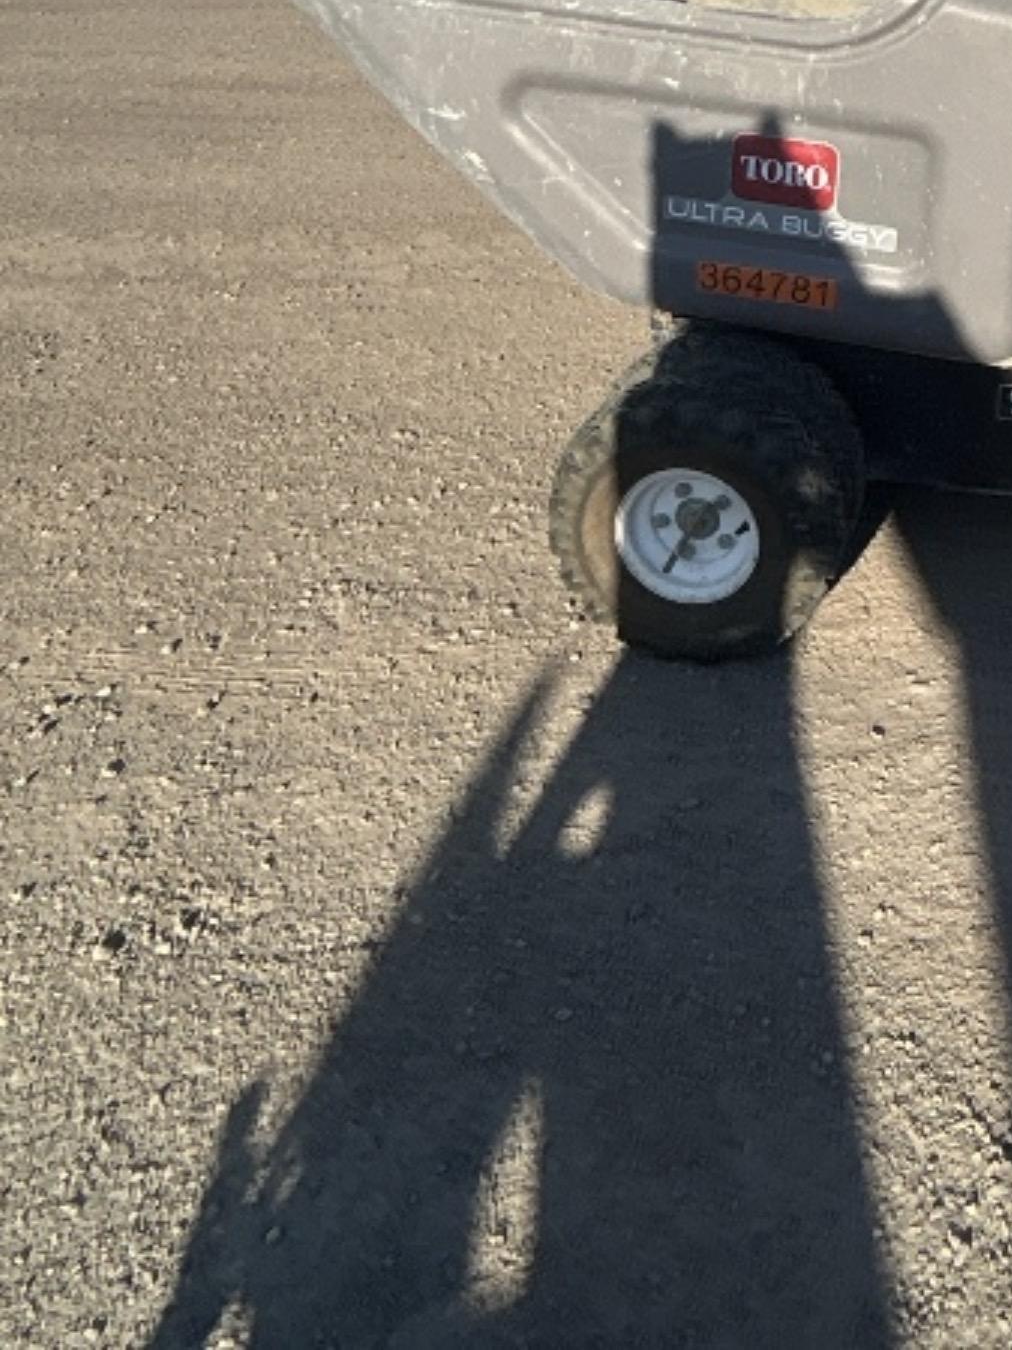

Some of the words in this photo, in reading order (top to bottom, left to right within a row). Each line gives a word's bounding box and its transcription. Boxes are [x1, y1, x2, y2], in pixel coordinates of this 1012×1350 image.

[740, 154, 829, 191] TORO
[667, 198, 769, 230] ULTRA
[781, 215, 890, 249] BUGGY
[700, 262, 830, 307] 364781
